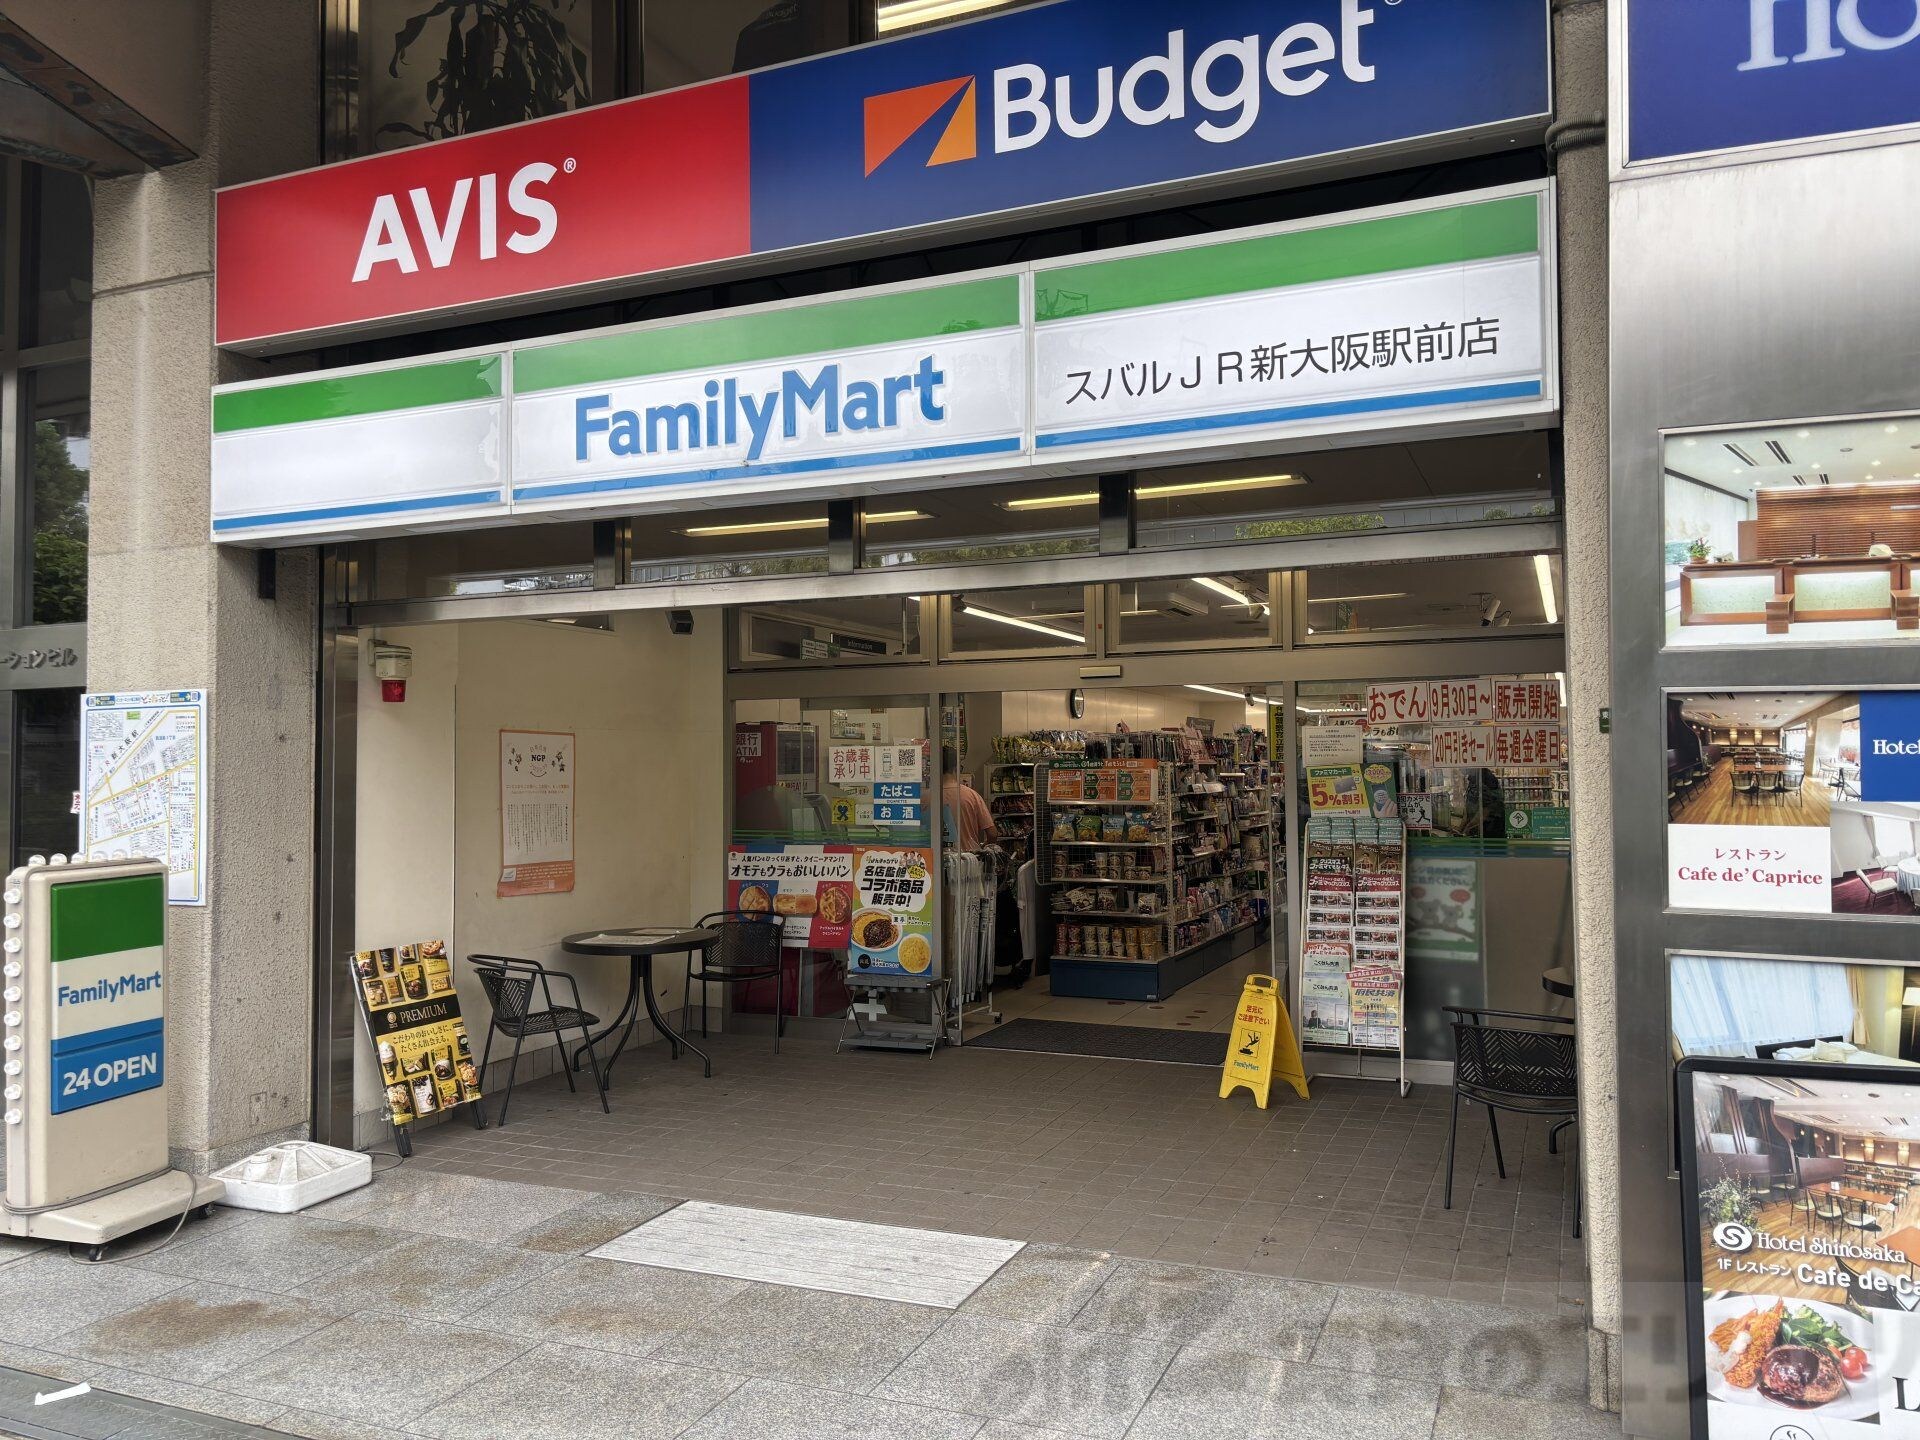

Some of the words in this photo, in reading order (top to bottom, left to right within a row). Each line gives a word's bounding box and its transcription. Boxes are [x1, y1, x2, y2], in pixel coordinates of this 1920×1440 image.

[993, 0, 1375, 154] Budget
[575, 354, 946, 464] FamilyMart
[1369, 686, 1427, 722] おでん
[1497, 683, 1560, 720] 販売開始
[833, 748, 870, 763] お歳暮
[1434, 728, 1494, 764] 20円引きセール
[1496, 728, 1560, 764] 毎週金曜日
[834, 763, 870, 779] 承り中
[881, 784, 913, 797] たばこ
[1714, 848, 1786, 861] レストラン
[860, 878, 925, 894] コラボ商品
[1678, 867, 1717, 881] Cafe
[1752, 869, 1823, 887] Caprice
[58, 971, 162, 1007] FamilyMart
[400, 1002, 448, 1024] PREMIUM
[62, 1068, 92, 1096] 24
[95, 1052, 157, 1087] OPEN
[1757, 1232, 1807, 1253] Hotel
[1717, 1258, 1732, 1271] 1F
[1736, 1260, 1792, 1276] レストラン
[1797, 1263, 1851, 1288] Cafe
